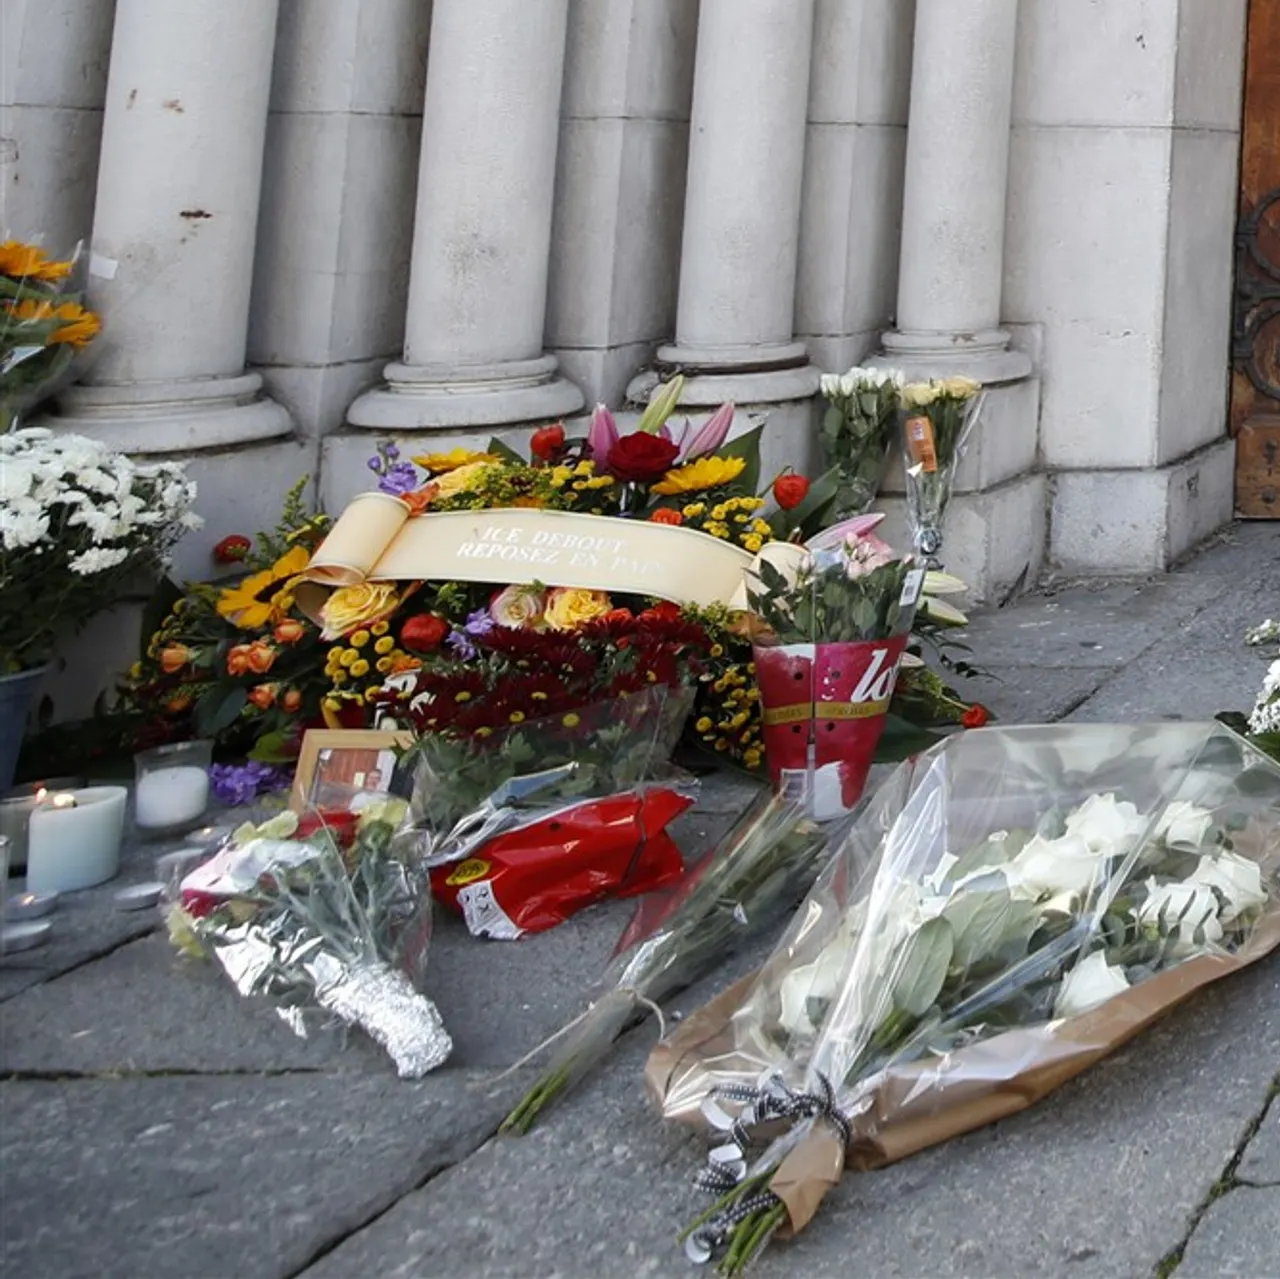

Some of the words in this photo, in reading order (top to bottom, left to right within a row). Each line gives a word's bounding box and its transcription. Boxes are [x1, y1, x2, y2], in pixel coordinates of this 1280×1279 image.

[476, 526, 523, 544] ICE
[530, 530, 626, 553] DEBOUT
[456, 541, 561, 565] REPOSEZ
